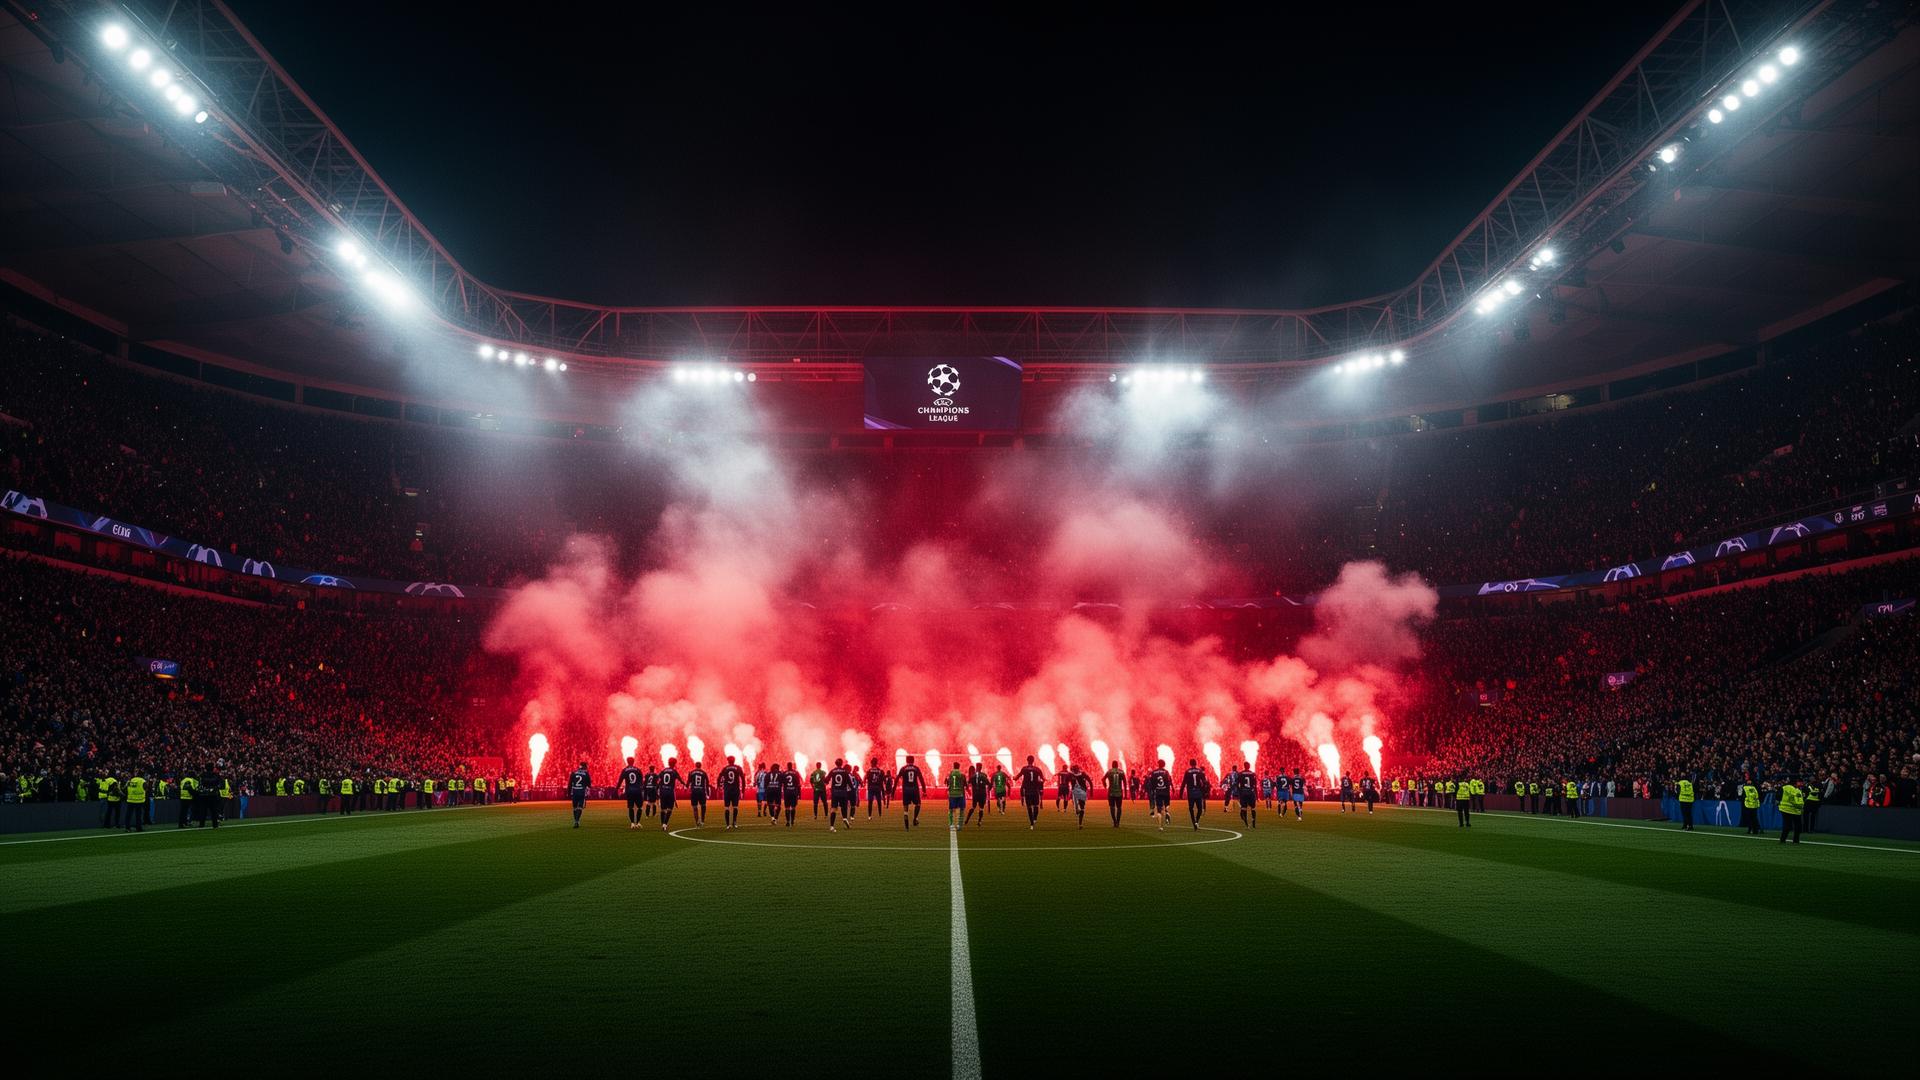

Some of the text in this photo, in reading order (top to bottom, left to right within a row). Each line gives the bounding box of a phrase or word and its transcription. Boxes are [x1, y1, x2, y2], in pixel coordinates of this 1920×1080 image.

[575, 775, 583, 787] 2
[629, 772, 637, 784] 9
[727, 771, 735, 784] 9
[834, 774, 843, 787] 9
[1157, 775, 1165, 787] 3
